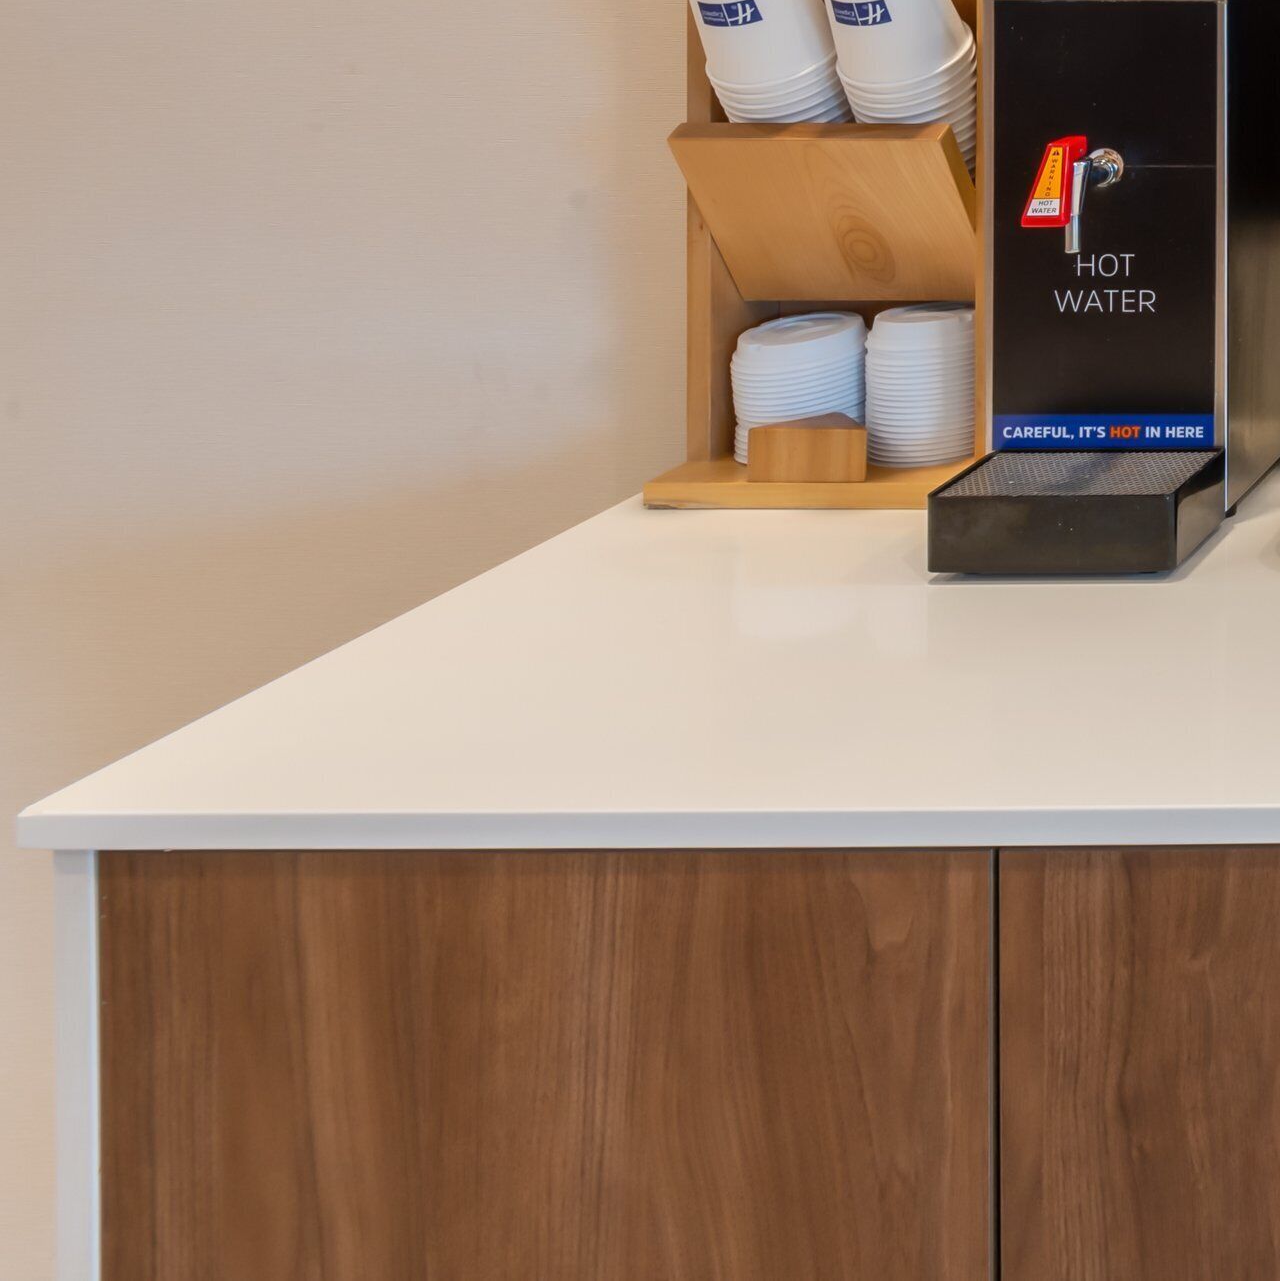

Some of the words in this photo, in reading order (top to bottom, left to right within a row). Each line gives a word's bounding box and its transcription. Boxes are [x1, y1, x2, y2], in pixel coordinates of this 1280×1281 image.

[1077, 254, 1135, 277] HOT
[1054, 290, 1156, 313] WATER
[1002, 426, 1075, 440] CAREFUL,
[1079, 426, 1106, 438] IT'S
[1110, 426, 1141, 439] HOT
[1145, 427, 1161, 438] IN
[1165, 427, 1204, 438] HERE
